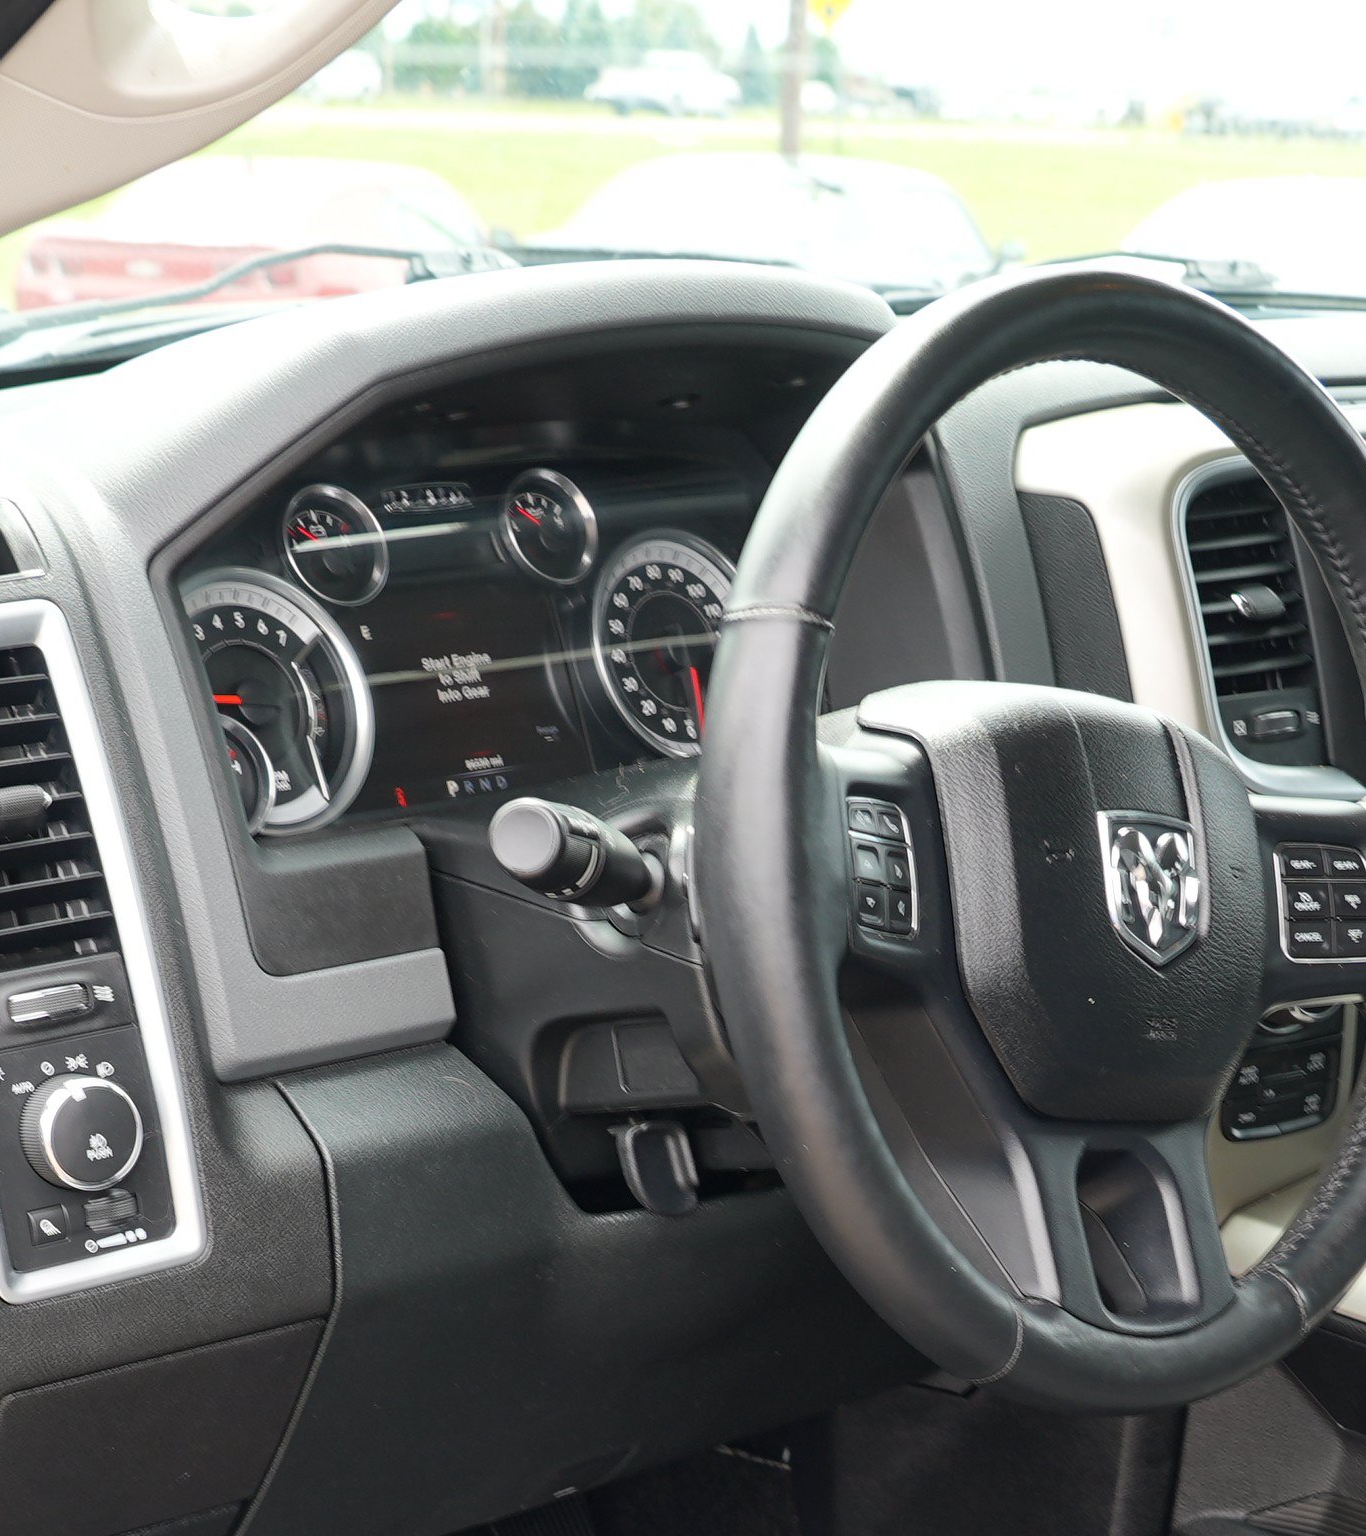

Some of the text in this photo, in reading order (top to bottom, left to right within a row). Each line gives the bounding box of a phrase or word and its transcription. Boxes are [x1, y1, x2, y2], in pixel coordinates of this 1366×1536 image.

[645, 564, 662, 580] 80
[667, 568, 684, 583] 90
[626, 575, 644, 591] 70
[685, 583, 706, 599] 100
[613, 592, 629, 608] 60
[702, 603, 723, 619] 110
[193, 611, 287, 647] 3 4 5 6 7
[359, 624, 373, 641] E
[608, 618, 625, 635] 50
[421, 651, 493, 672] Start Engine
[611, 648, 626, 664] 40
[453, 667, 482, 685] Shift
[622, 676, 639, 692] 30
[461, 685, 491, 701] Gear
[640, 699, 657, 716] 20
[661, 717, 677, 733] 10
[446, 775, 508, 798] P R N D
[11, 1081, 35, 1095] AUTO
